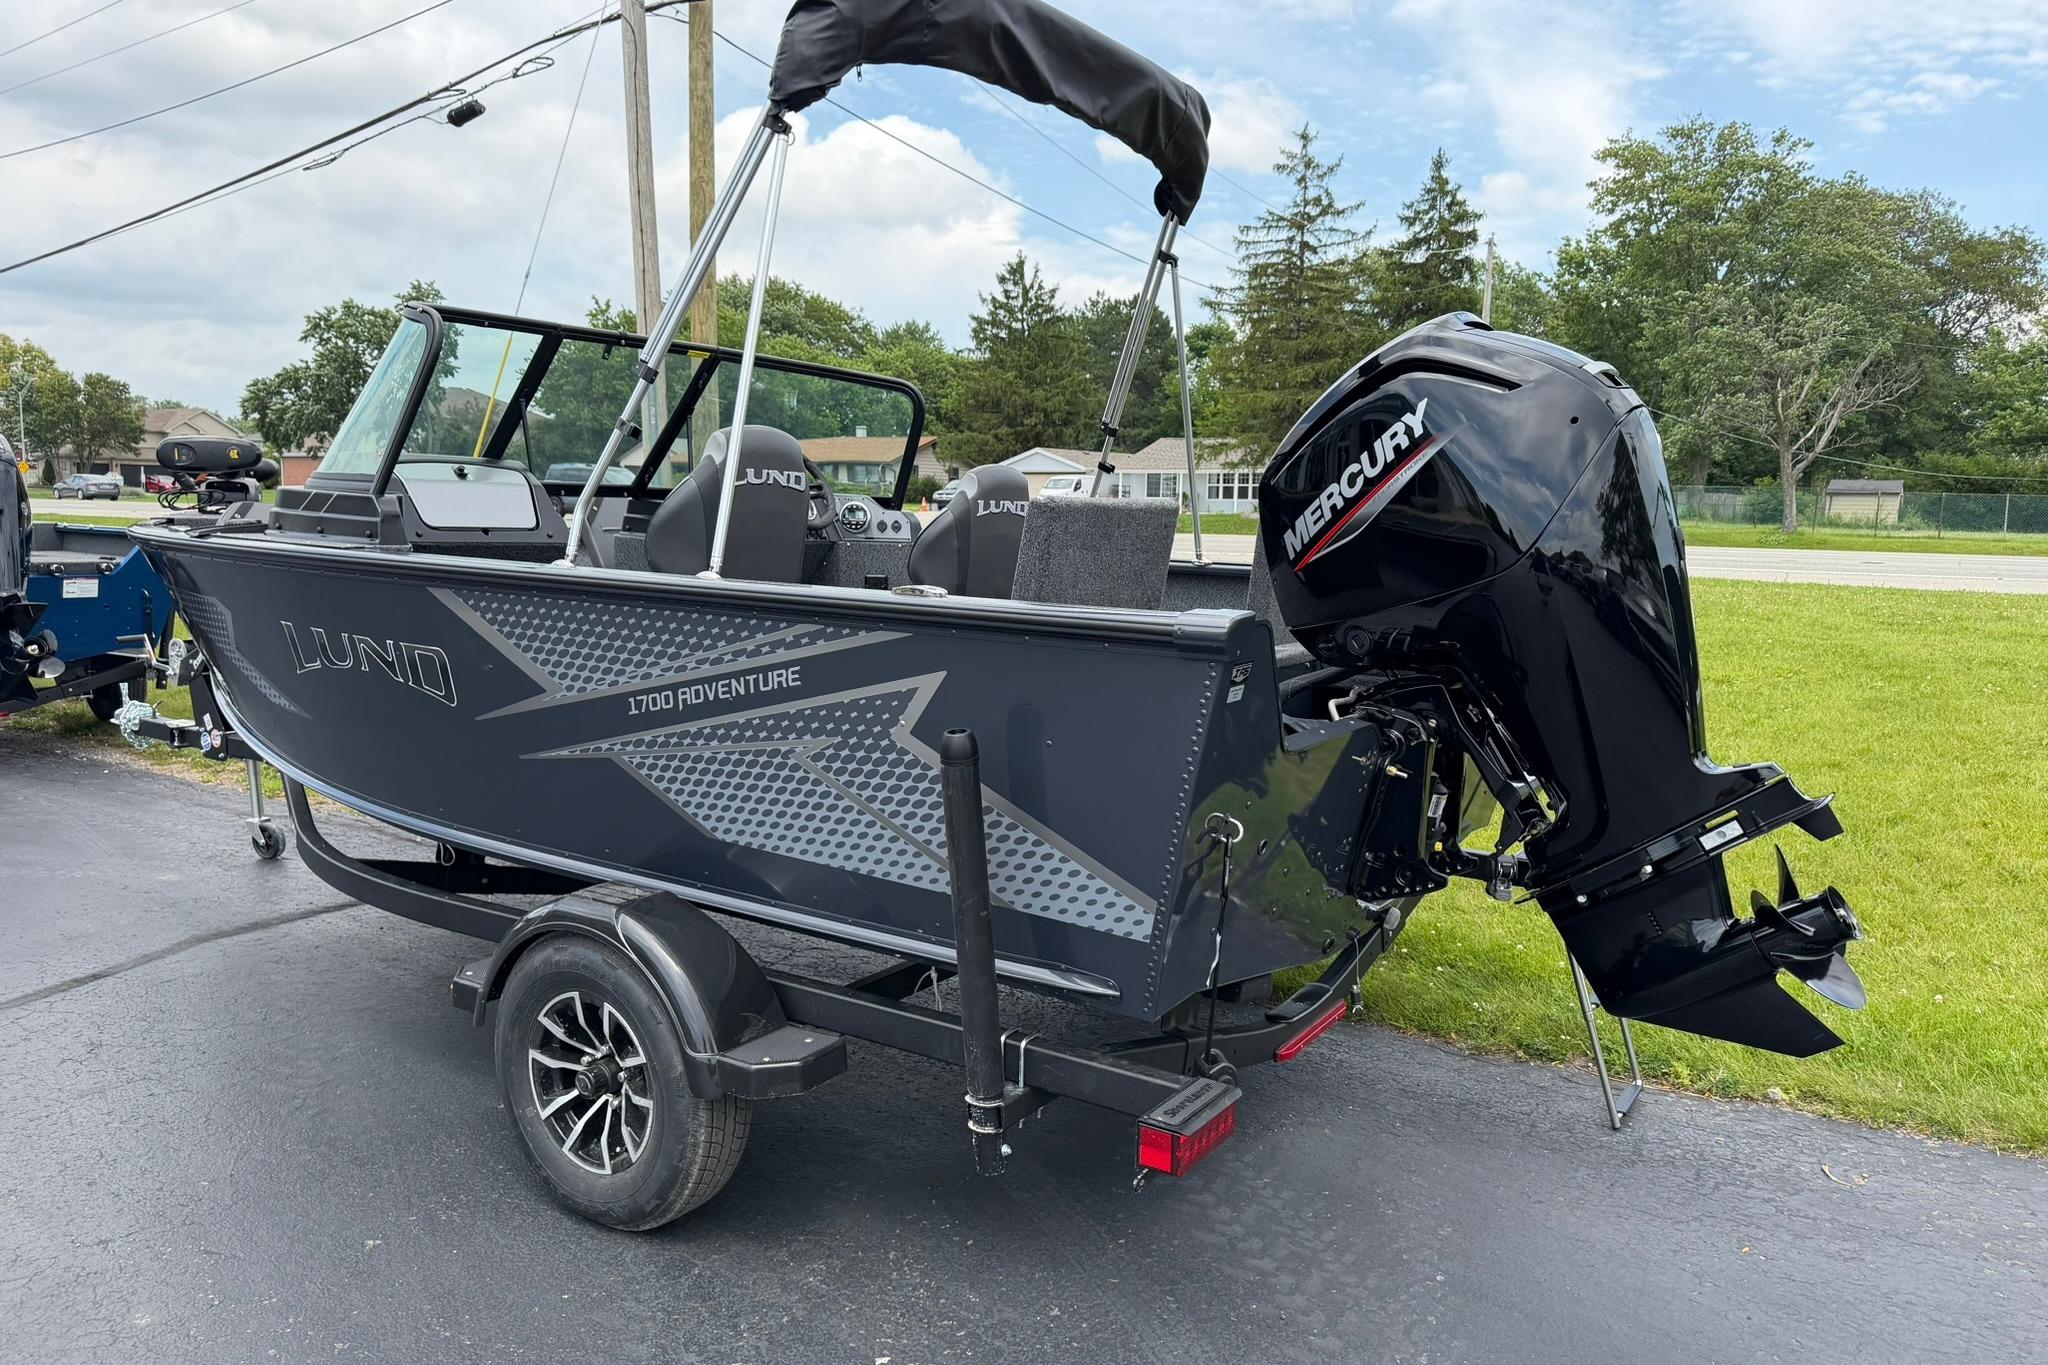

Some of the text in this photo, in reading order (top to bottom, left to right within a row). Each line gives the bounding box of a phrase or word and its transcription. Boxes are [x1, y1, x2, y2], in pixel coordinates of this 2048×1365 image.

[976, 499, 1029, 517] LUND
[1283, 398, 1428, 560] MERCURY
[280, 620, 457, 707] LUND
[628, 666, 802, 715] 1700 ADVENTURE
